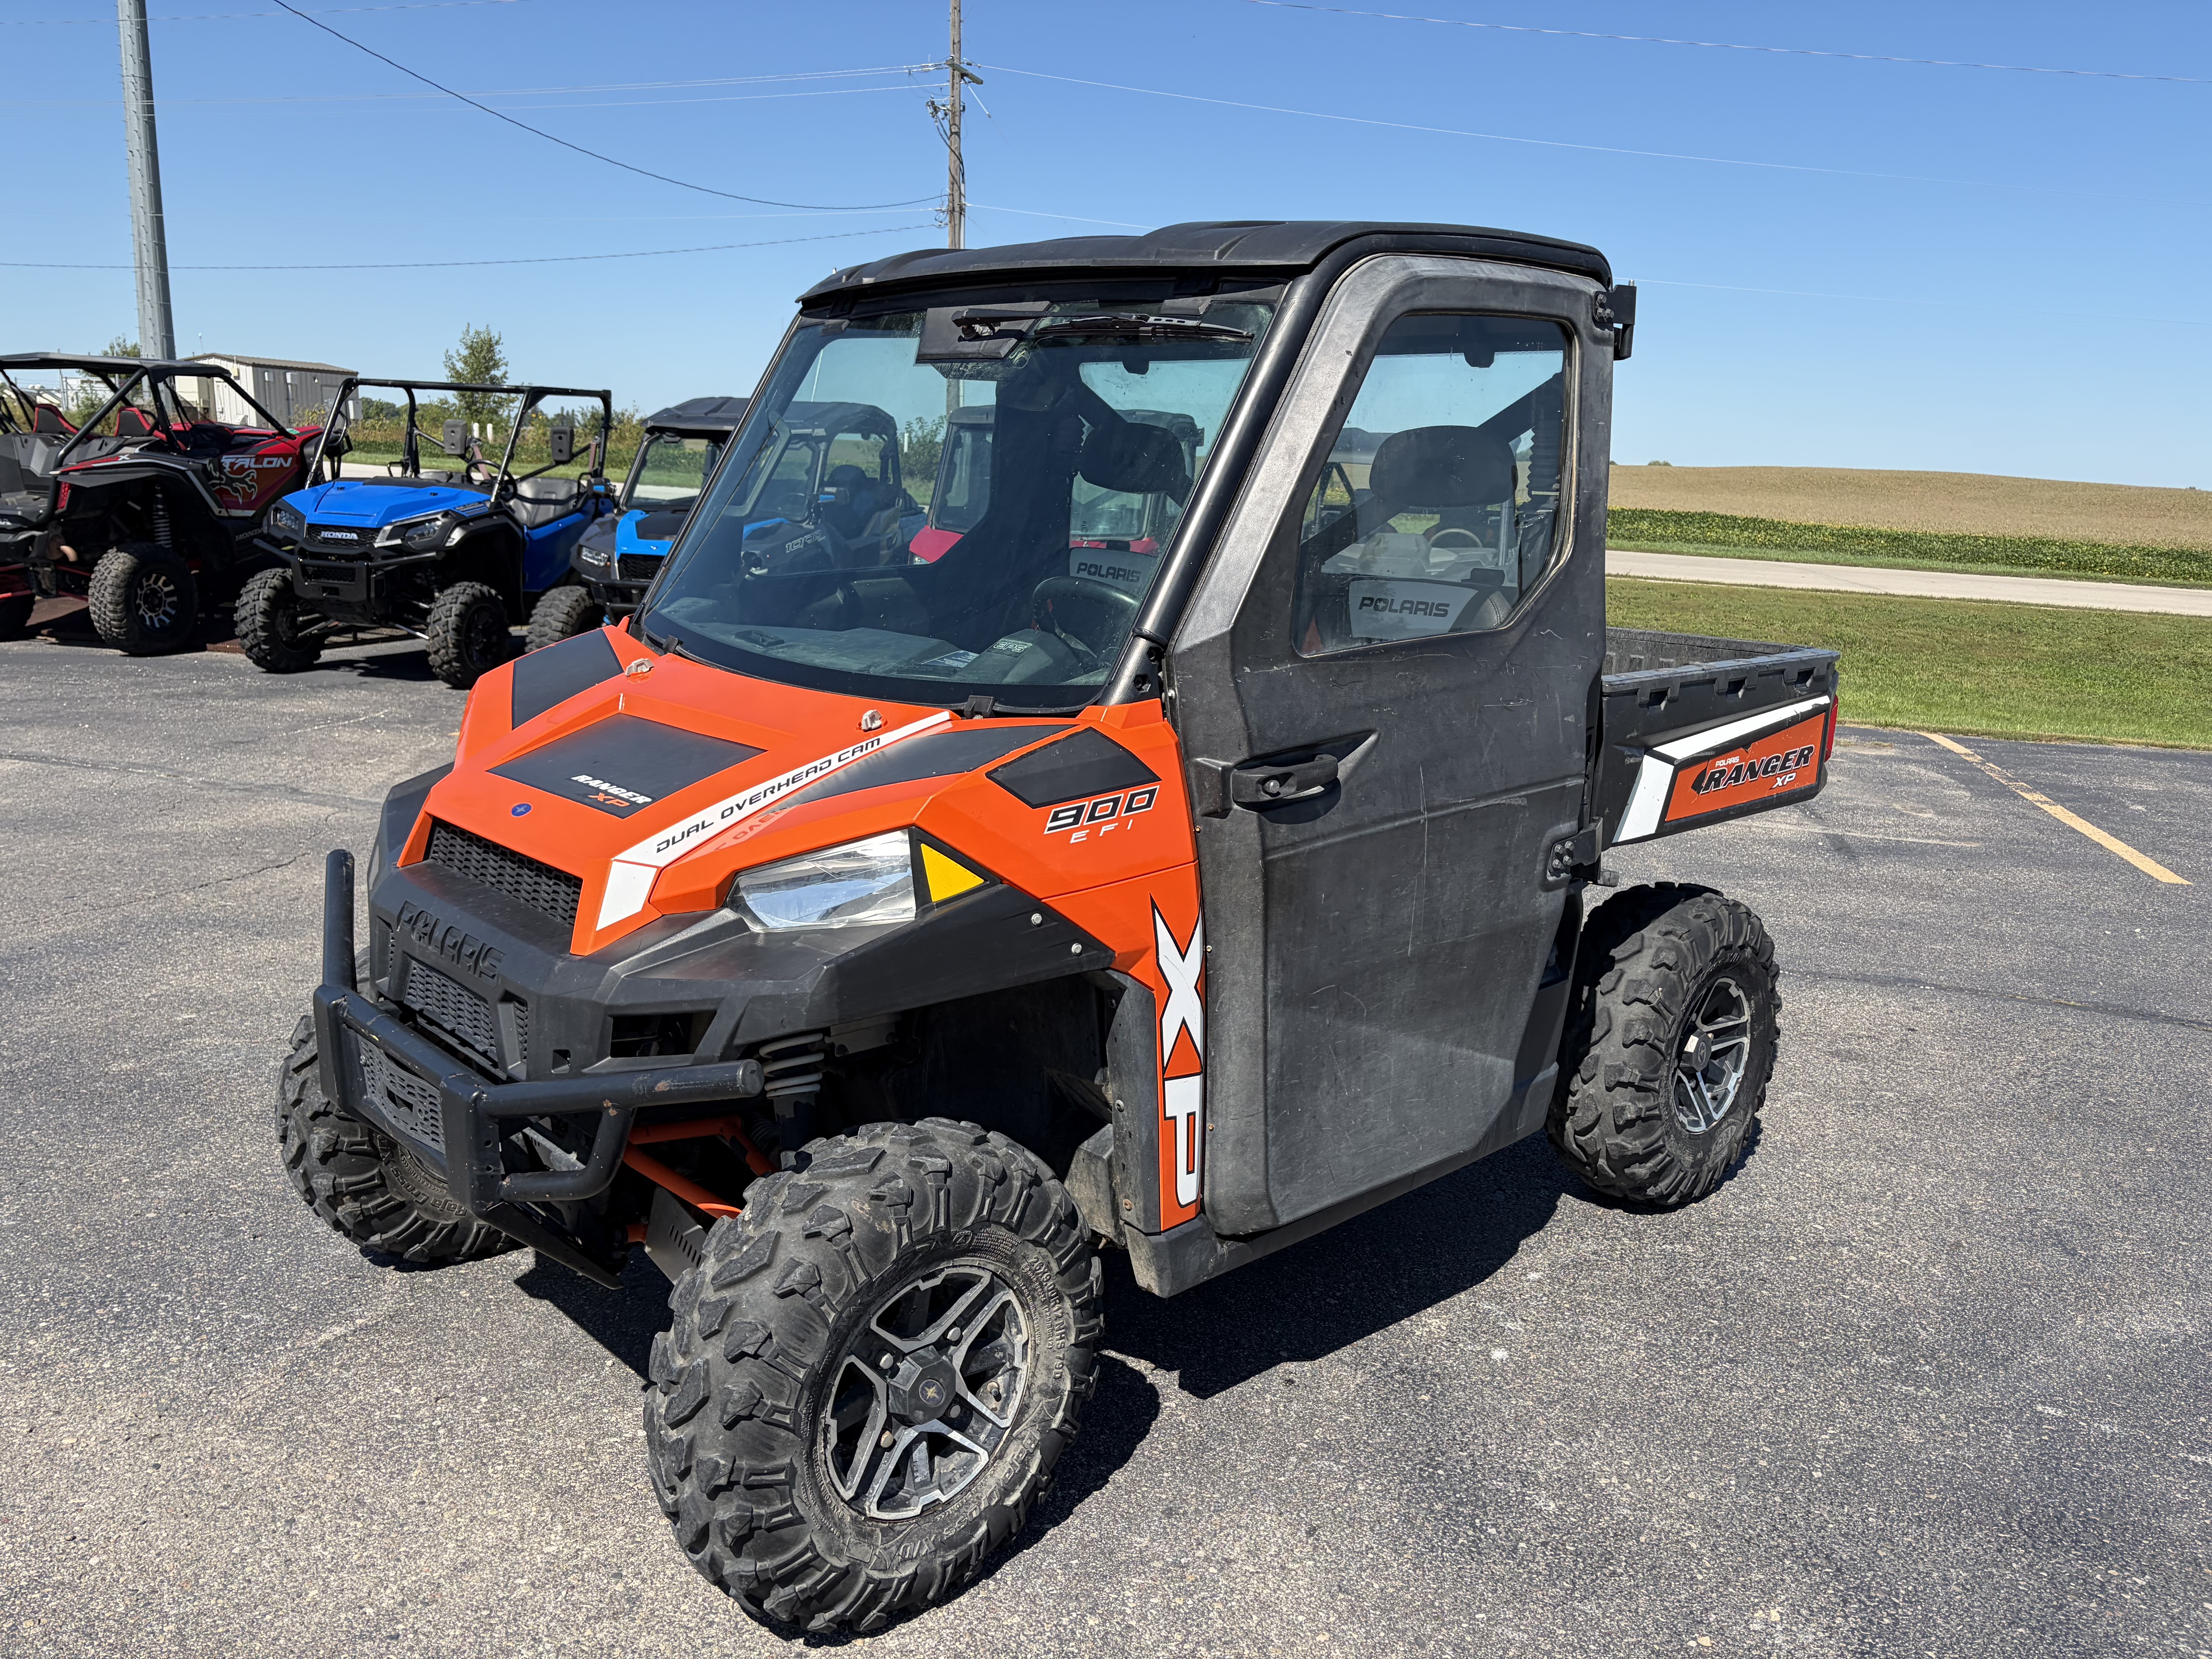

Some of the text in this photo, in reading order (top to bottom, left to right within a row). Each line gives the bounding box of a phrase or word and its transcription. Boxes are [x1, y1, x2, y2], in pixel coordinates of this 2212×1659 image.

[221, 455, 292, 471] TALON
[320, 531, 359, 540] HONDA
[1076, 562, 1142, 584] POLARIS
[1358, 596, 1450, 617] POLARIS
[993, 641, 1029, 653] EPS
[1700, 744, 1815, 796] RANGER
[1715, 756, 1740, 768] POLARIS
[571, 775, 653, 805] RANGER
[1772, 772, 1796, 789] XP
[587, 792, 630, 808] XP
[656, 738, 880, 854] DUAL OVERHEAD CAM
[1044, 785, 1160, 834] 900
[1070, 819, 1133, 844] EFI
[396, 900, 505, 986] POLARIS
[1149, 892, 1205, 1208] XP
[391, 1166, 429, 1205] Cross
[430, 1198, 467, 1216] Baja
[1029, 1255, 1064, 1320] 26X9.00R12
[1055, 1321, 1065, 1350] NHS
[1053, 1353, 1065, 1379] 79D
[1002, 1431, 1039, 1484] Baja
[812, 1447, 832, 1506] CONSTRUCTION
[943, 1485, 1001, 1540] Cross
